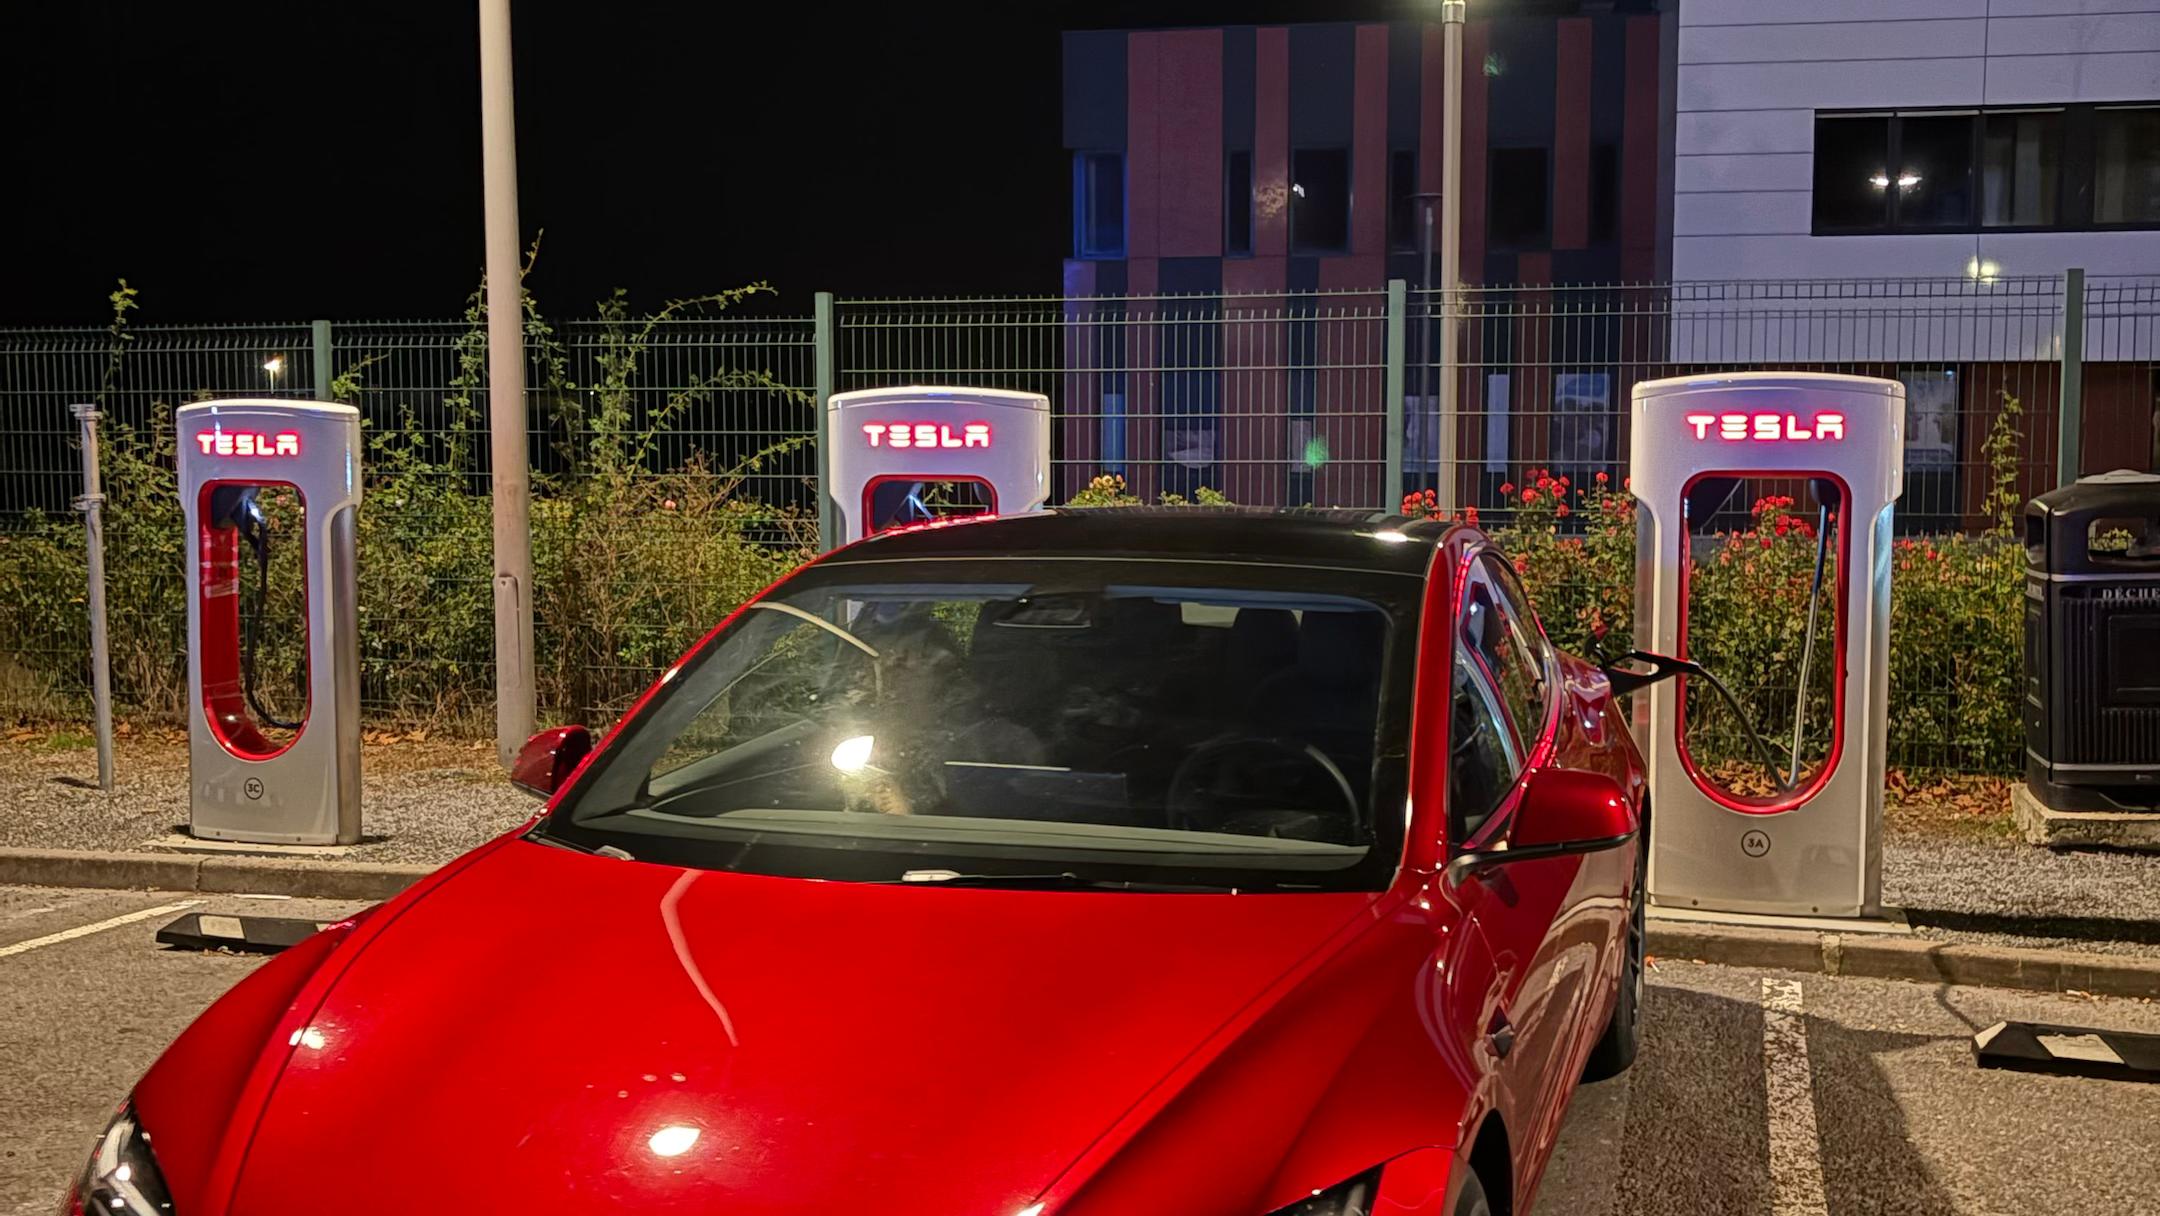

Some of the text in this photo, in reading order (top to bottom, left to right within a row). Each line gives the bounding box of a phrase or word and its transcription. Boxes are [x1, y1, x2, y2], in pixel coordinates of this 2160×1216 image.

[862, 423, 990, 448] TESLA
[1685, 412, 1845, 441] TESLA
[196, 432, 299, 456] TESLA
[247, 783, 260, 793] 3C
[1747, 837, 1764, 849] 3A
